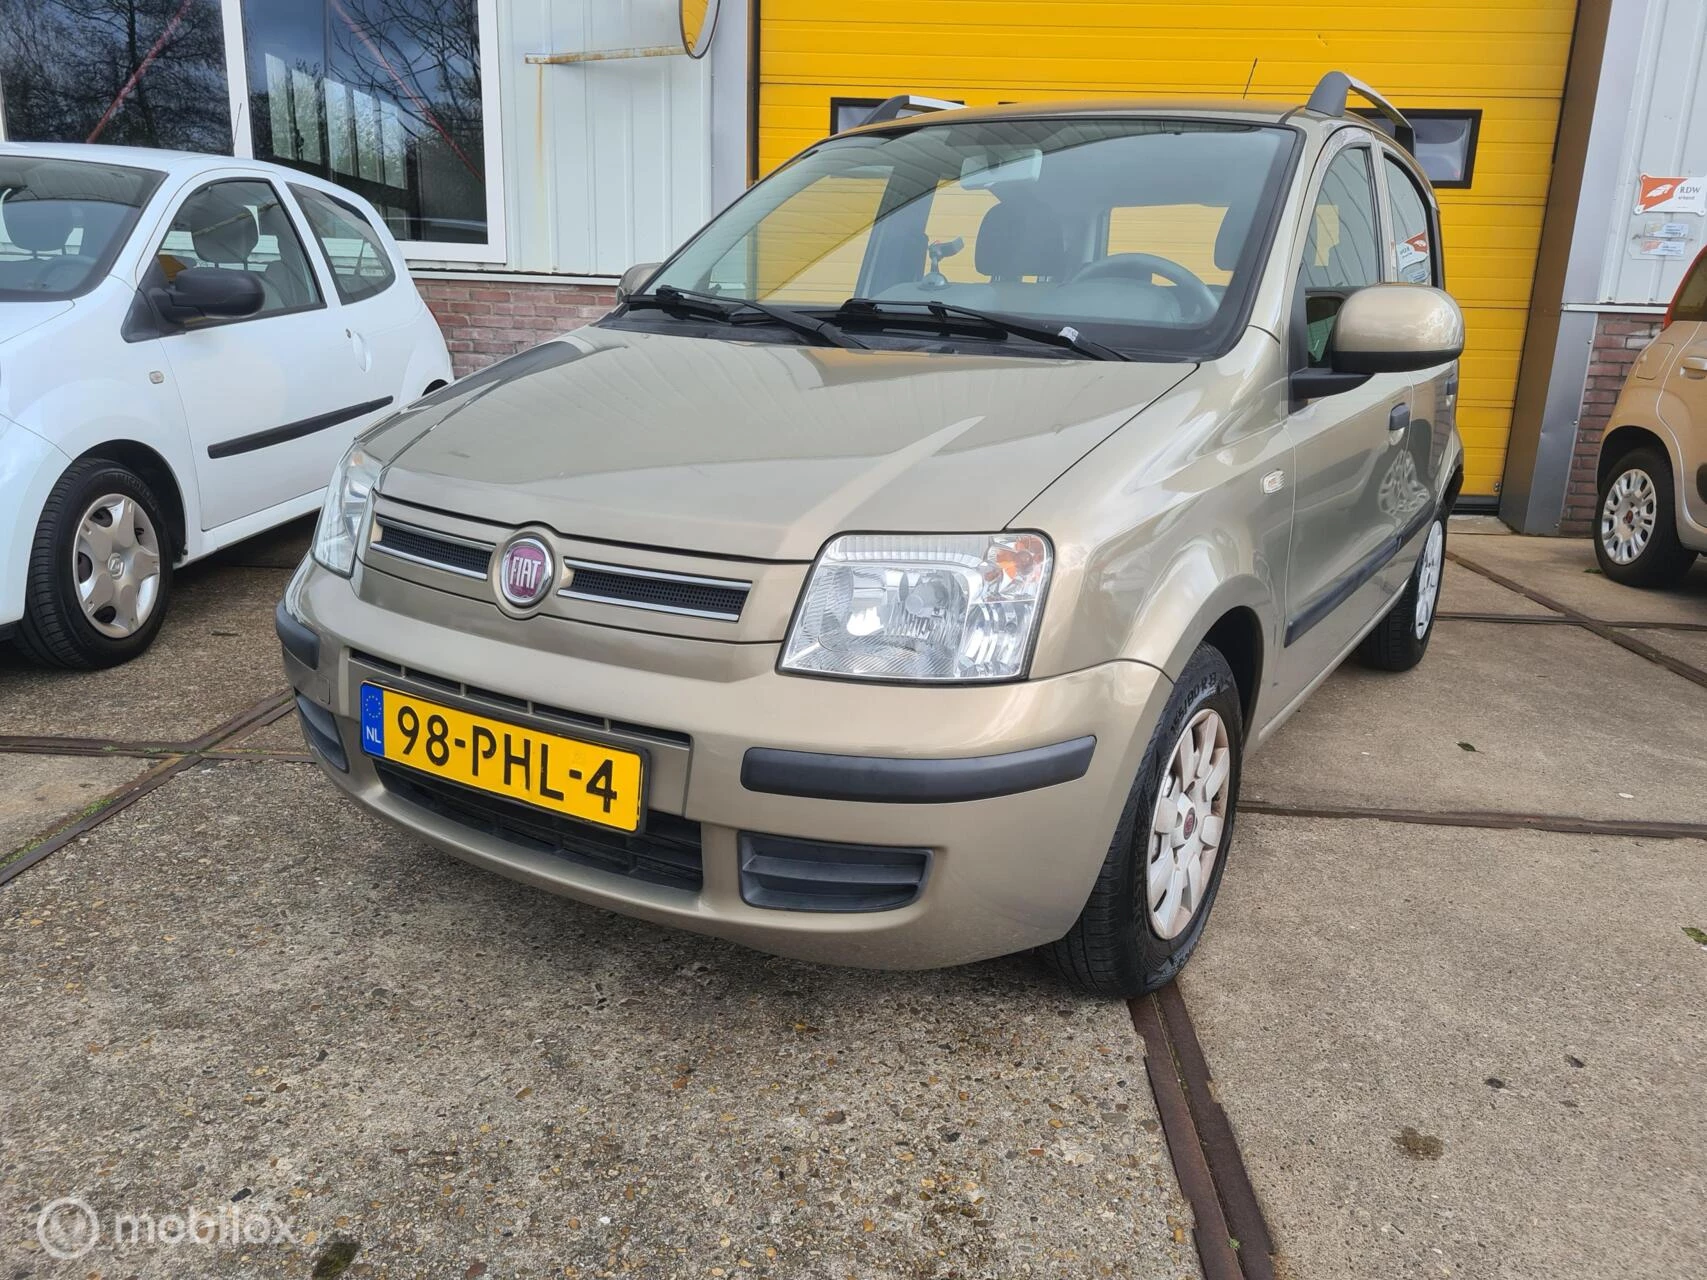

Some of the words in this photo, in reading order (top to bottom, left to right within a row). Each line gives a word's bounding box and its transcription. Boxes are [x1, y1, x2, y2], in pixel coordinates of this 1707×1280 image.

[1679, 186, 1701, 194] RDW
[509, 556, 542, 589] FIAT
[366, 726, 382, 744] NL
[397, 705, 618, 814] 98-PHL-4
